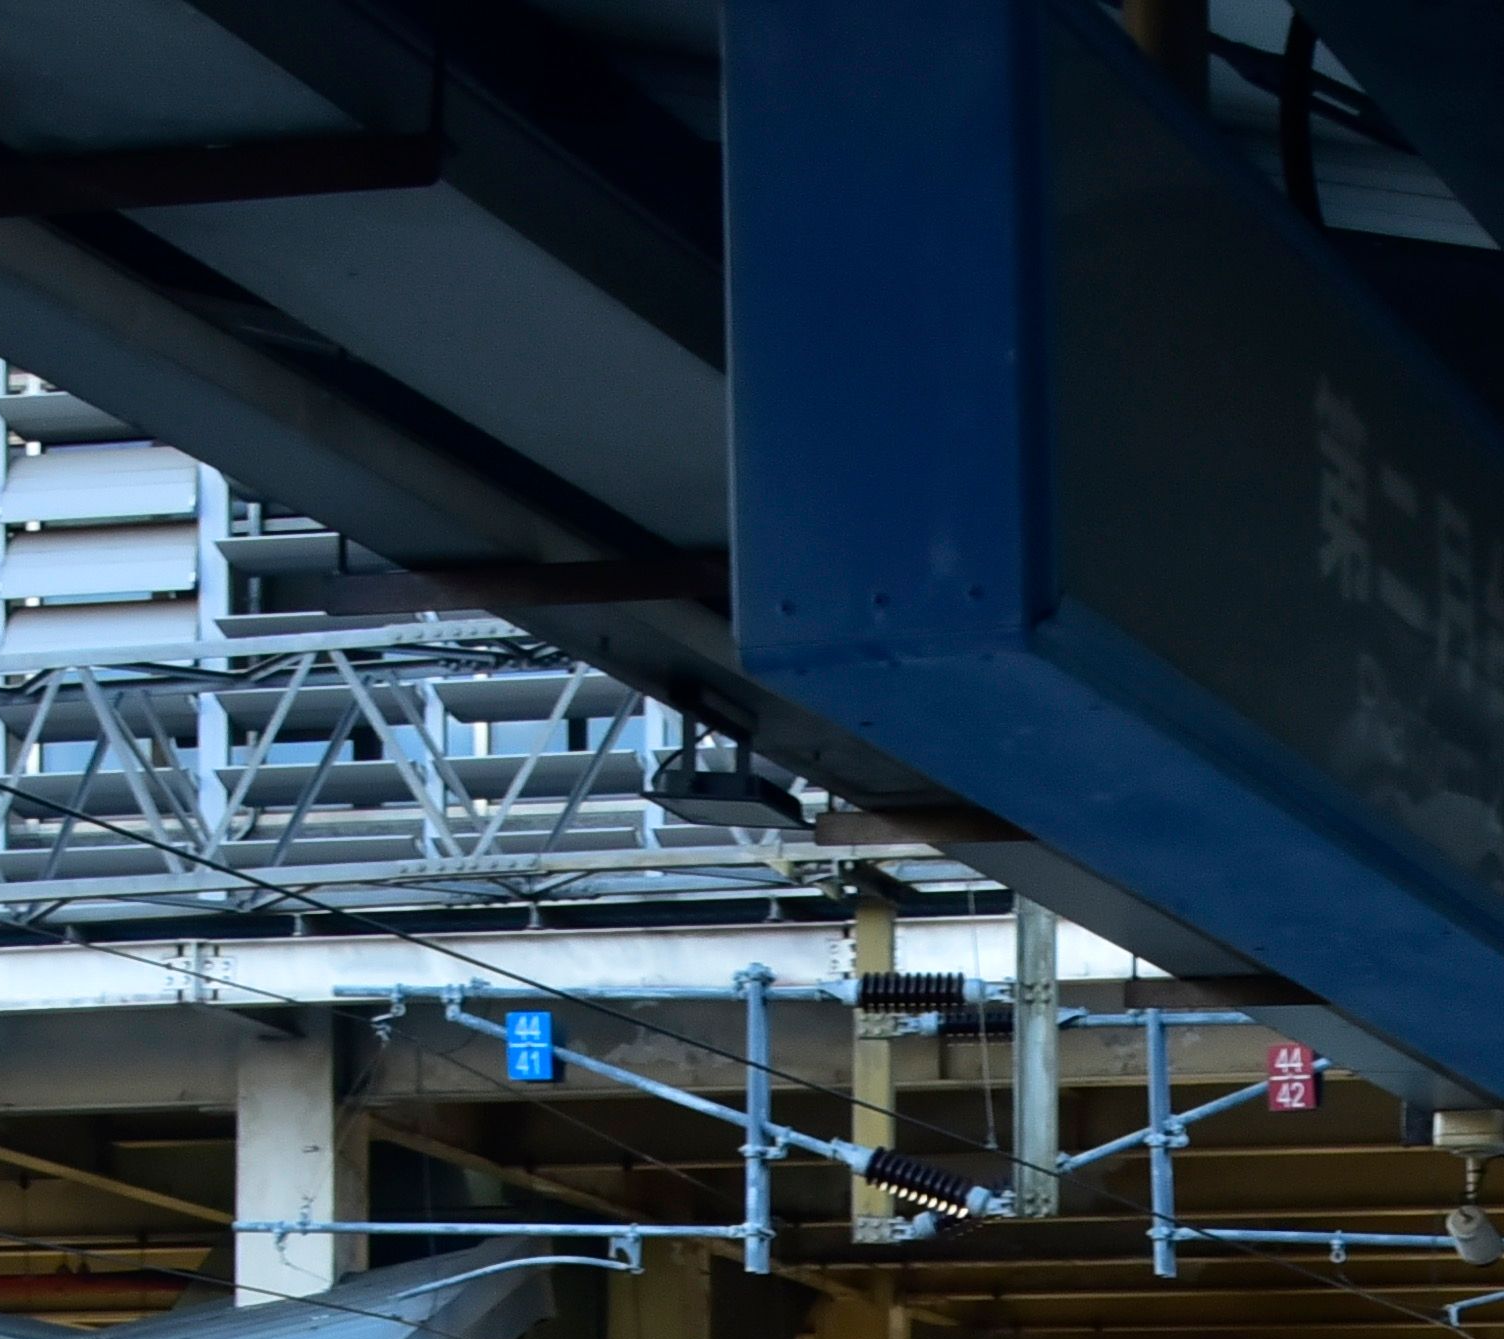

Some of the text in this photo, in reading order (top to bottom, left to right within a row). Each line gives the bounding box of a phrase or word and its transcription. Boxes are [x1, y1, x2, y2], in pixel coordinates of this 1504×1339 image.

[514, 1016, 541, 1040] 44
[515, 1050, 540, 1075] 41
[1274, 1047, 1303, 1073] 44
[1276, 1082, 1305, 1108] 42
